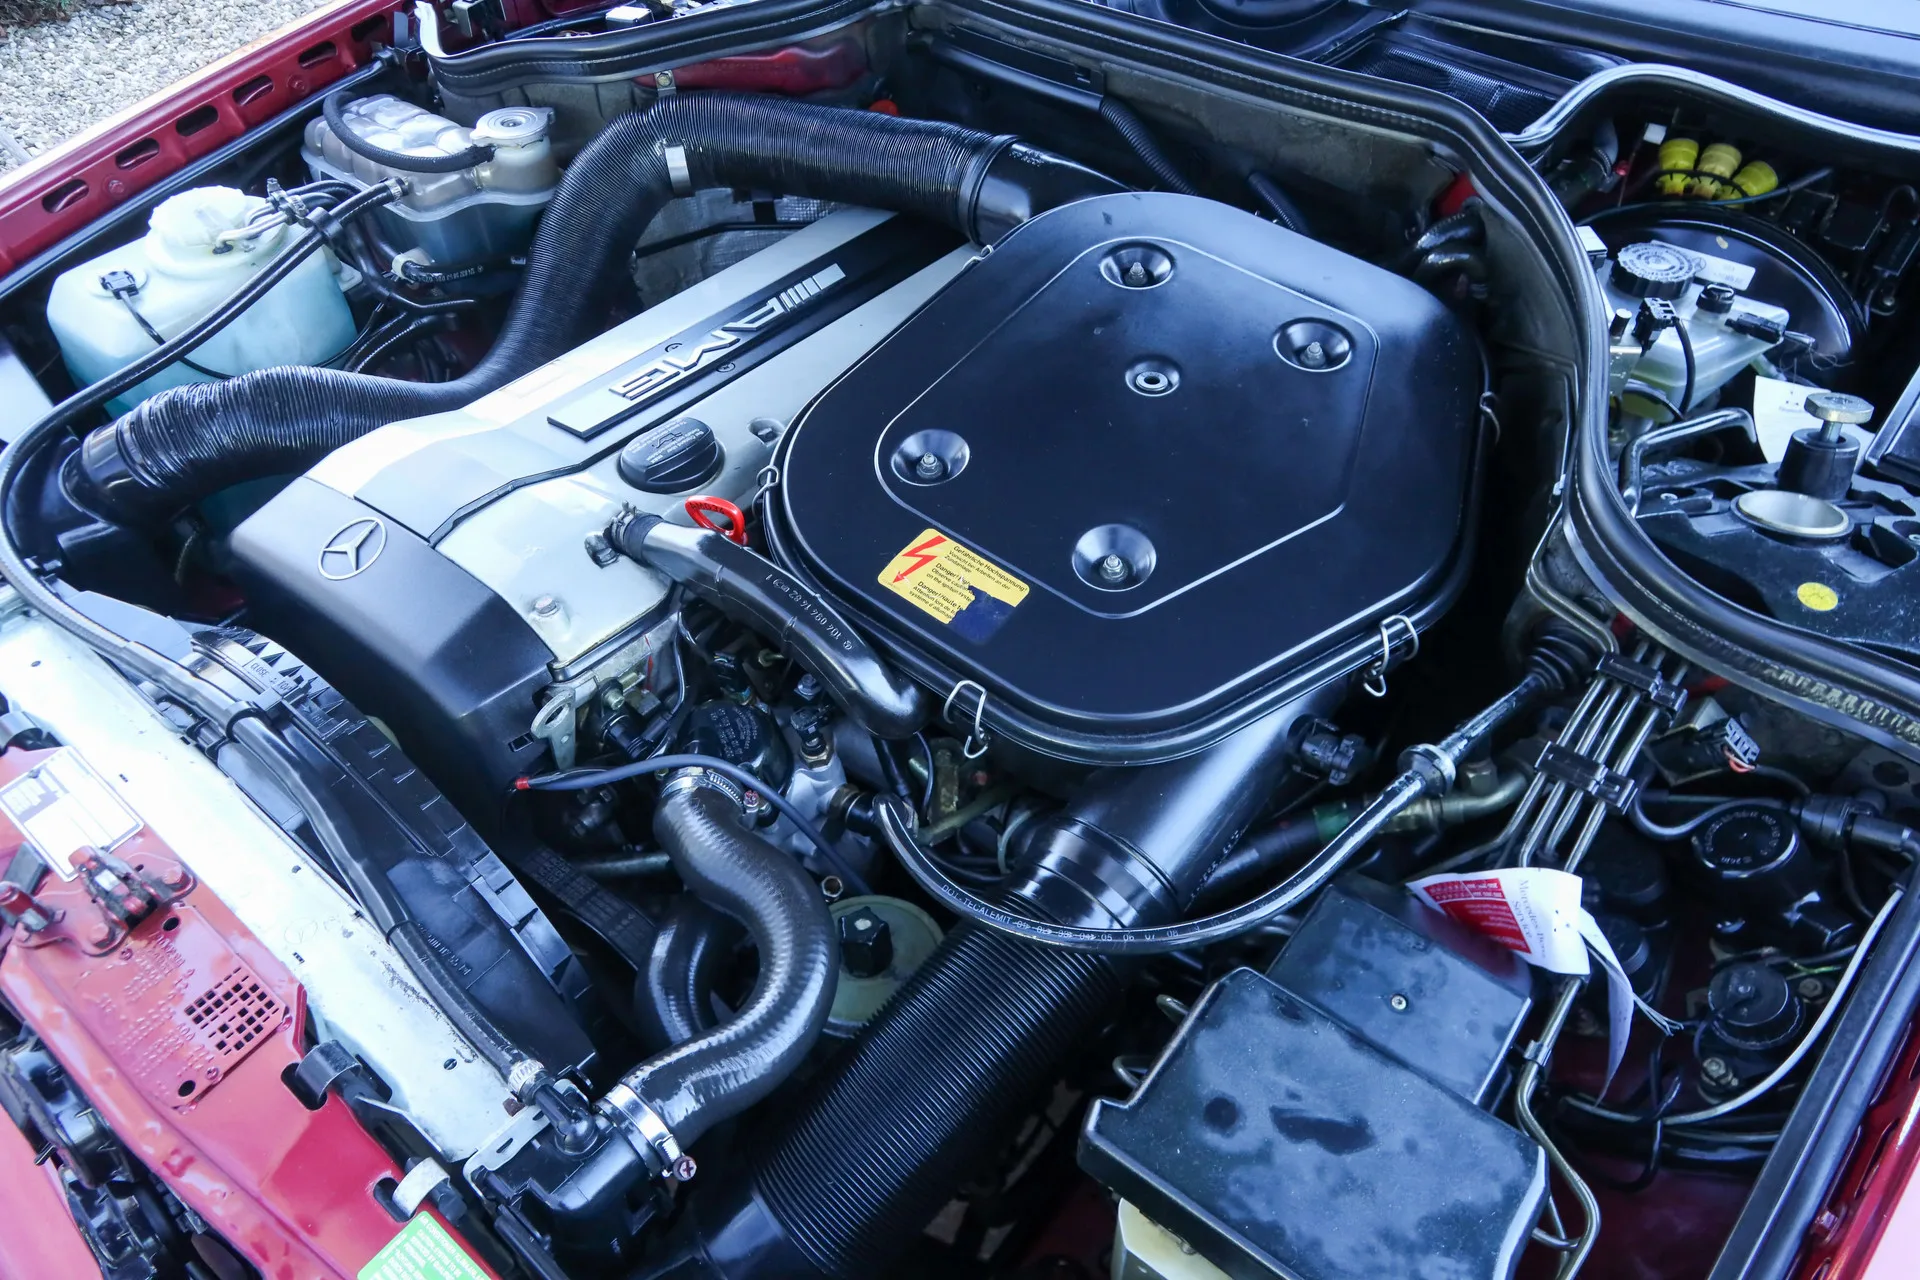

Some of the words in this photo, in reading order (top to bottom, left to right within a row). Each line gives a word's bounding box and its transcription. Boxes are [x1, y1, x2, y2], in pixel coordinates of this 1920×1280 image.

[609, 297, 785, 402] AMG
[930, 567, 953, 582] Observe
[933, 562, 959, 579] Danger!
[947, 550, 969, 564] Vorsicht
[974, 567, 996, 581] Arbeiten
[932, 576, 943, 584] the
[939, 581, 959, 595] ignition
[982, 564, 1028, 593] Hochspannung!
[788, 589, 802, 602] 82
[912, 585, 936, 601] Attention
[933, 598, 945, 607] lors
[916, 580, 941, 598] Danger!
[938, 594, 958, 607] Haute
[800, 599, 811, 610] 14
[809, 608, 827, 625] 094
[825, 624, 842, 639] 104
[250, 661, 269, 677] CLOSE
[1512, 899, 1532, 938] Service
